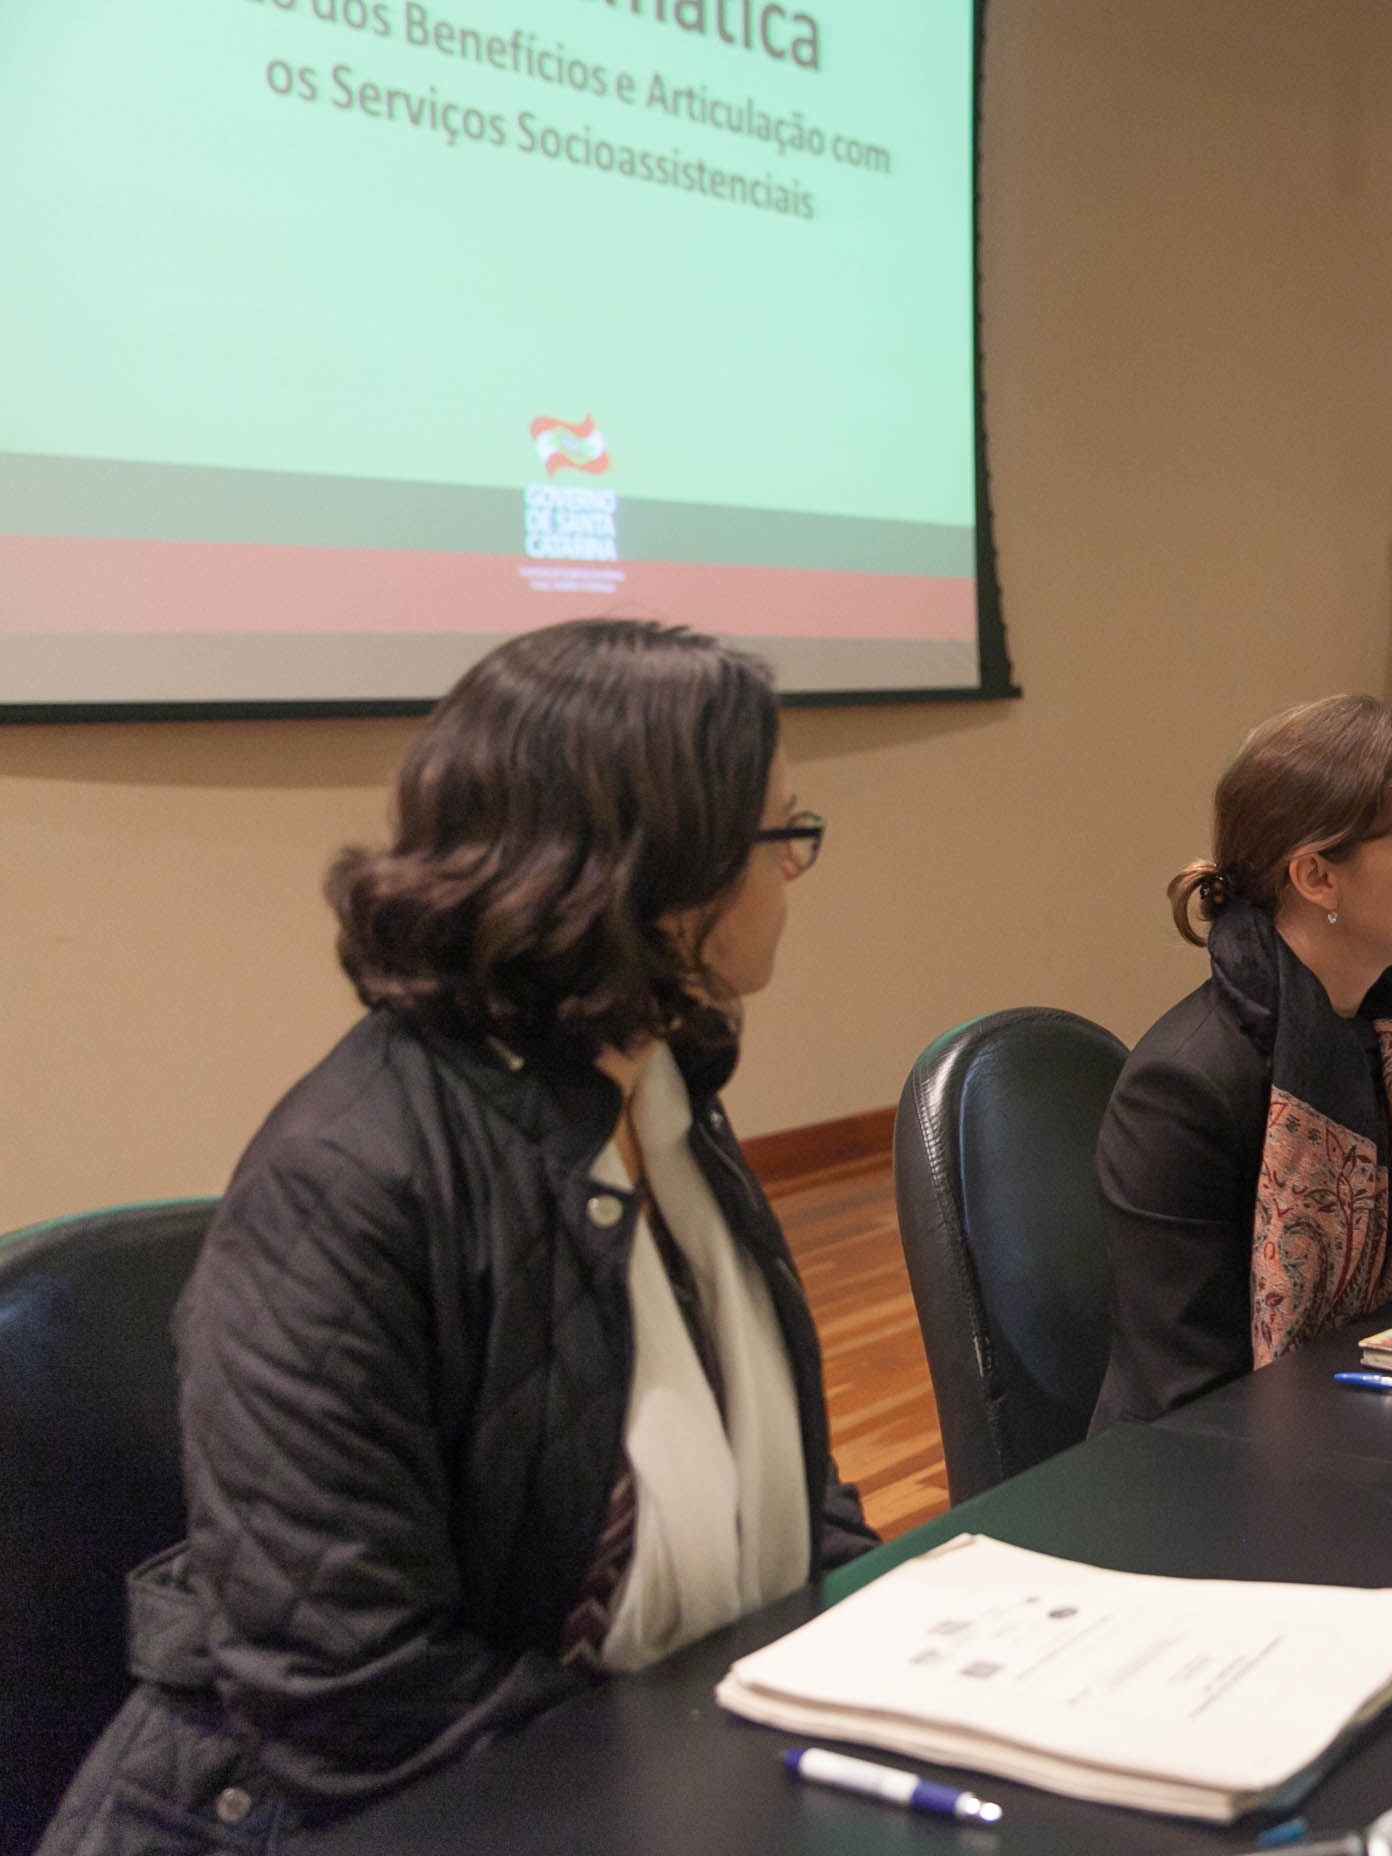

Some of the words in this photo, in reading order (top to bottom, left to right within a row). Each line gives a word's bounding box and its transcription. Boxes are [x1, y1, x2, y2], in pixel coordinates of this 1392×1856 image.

[266, 59, 318, 102] os
[331, 64, 507, 147] Serviços
[517, 111, 816, 220] Socioassistenciais
[616, 71, 637, 104] e
[646, 73, 826, 157] Articulação
[832, 133, 892, 174] com
